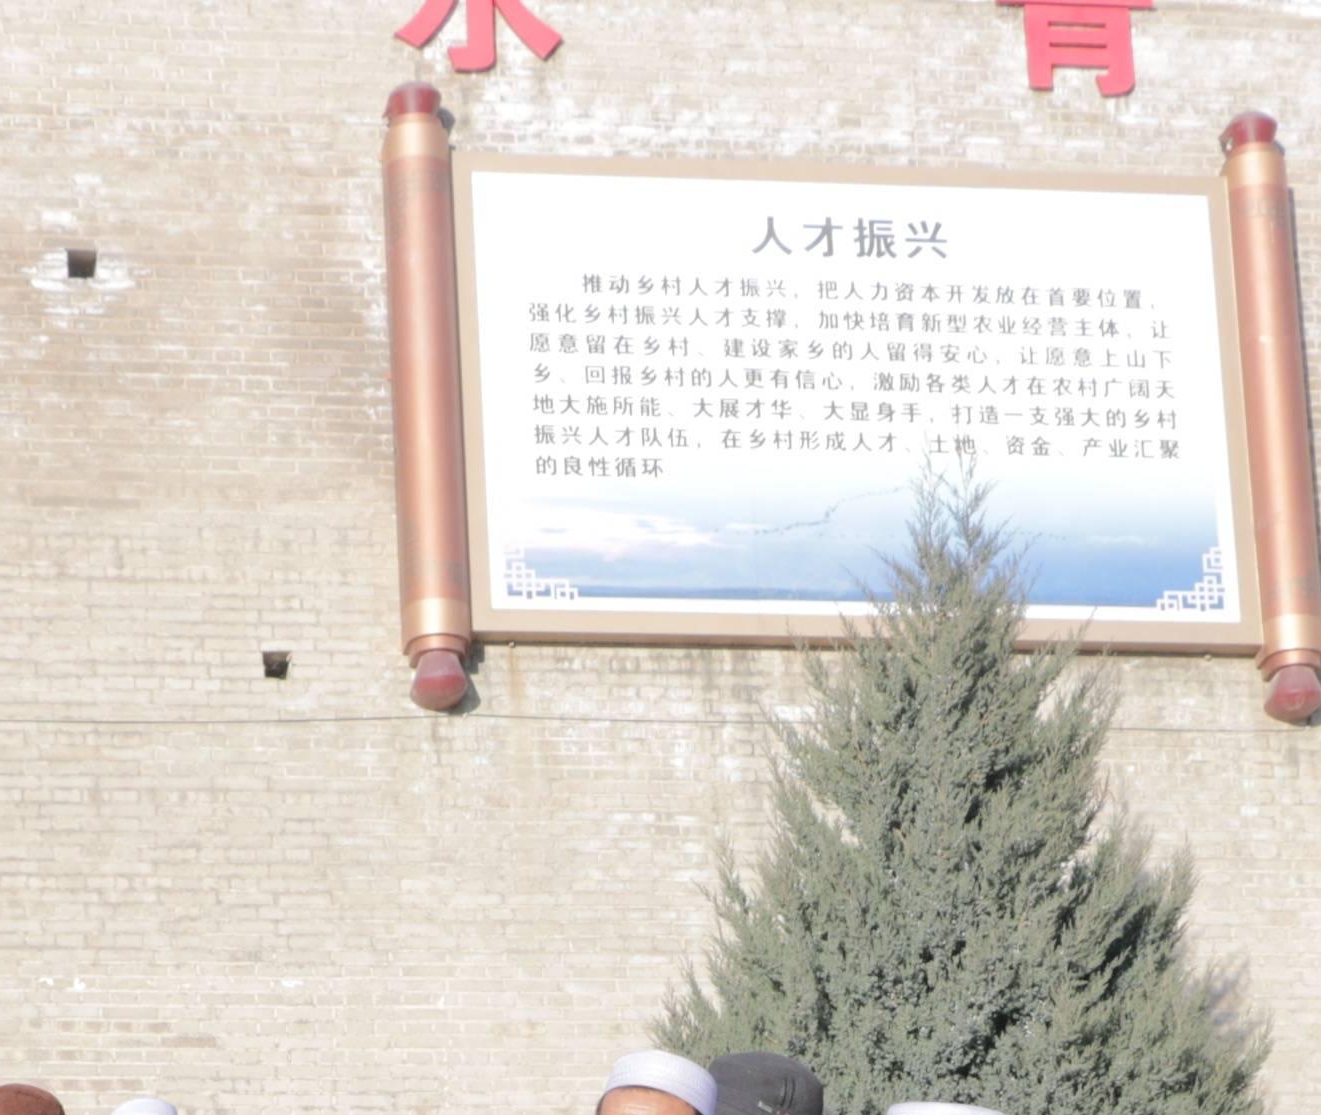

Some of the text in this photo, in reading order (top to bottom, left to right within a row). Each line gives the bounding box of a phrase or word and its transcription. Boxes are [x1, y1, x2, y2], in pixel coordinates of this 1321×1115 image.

[751, 216, 949, 259] 人才振兴
[535, 455, 666, 479] 的良性循环
